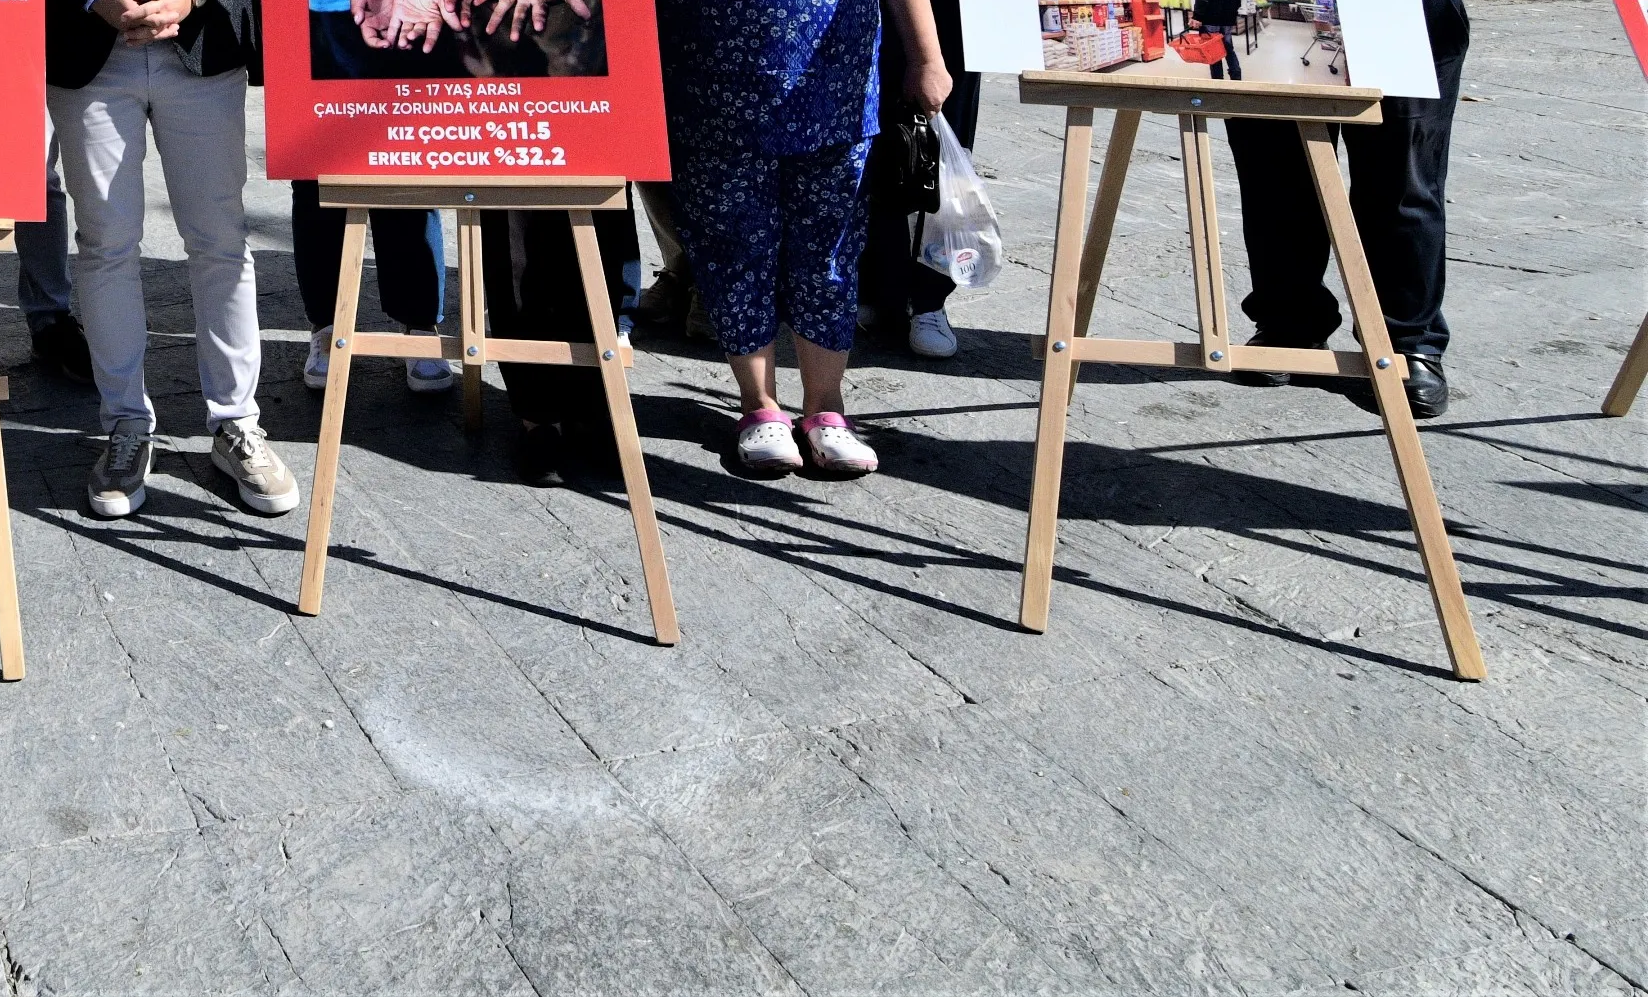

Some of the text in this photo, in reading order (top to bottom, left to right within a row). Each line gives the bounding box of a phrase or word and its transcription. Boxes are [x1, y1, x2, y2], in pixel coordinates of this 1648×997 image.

[395, 83, 521, 99] 15 17 YAŞ ARASI
[313, 101, 610, 118] ÇALIŞMAK ZORUNDA KALAN ÇOCUKLAR
[387, 121, 551, 144] KIZ ÇOCUK %11.5
[368, 147, 566, 169] ERKEK ÇOCUK %32.2
